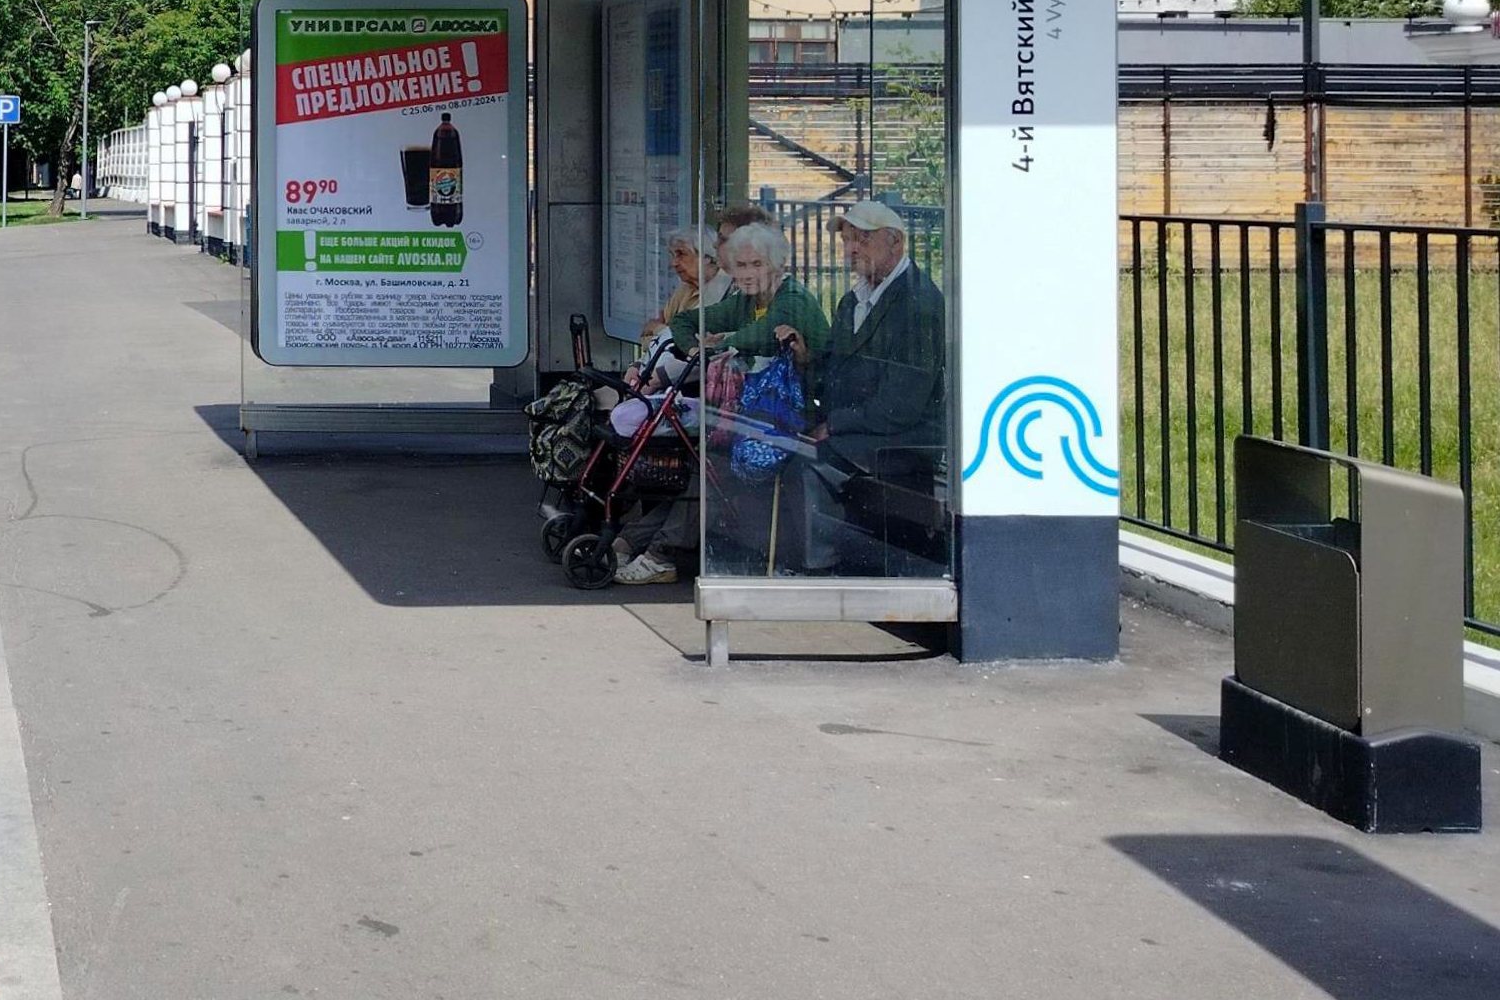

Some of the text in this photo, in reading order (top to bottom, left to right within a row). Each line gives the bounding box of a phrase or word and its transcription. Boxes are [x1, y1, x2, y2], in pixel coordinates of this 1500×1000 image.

[290, 20, 499, 32] УНИВЕРСАМ АВОСЬКА
[1047, 25, 1062, 40] 4
[291, 46, 451, 90] СПЕЦИАЛЬНОЕ
[295, 71, 464, 116] ПРЕДЛОЖЕНИЕ
[0, 99, 14, 120] P
[410, 105, 434, 115] 25.06
[435, 104, 446, 113] по
[448, 96, 496, 110] 08.07.2024
[1012, 126, 1034, 173] 4-й
[287, 205, 373, 215] Квас ОЧАКОВСКИЙ
[286, 217, 331, 227] заварной,
[320, 236, 457, 248] ЕЩЕ БОЛЬШЕ АКЦИЙ И СКИДОК
[320, 252, 462, 266] НА НАШЕМ САЙТЕ AVOSKA.RU
[324, 278, 362, 288] Москва,
[381, 278, 443, 288] Башиловская,
[459, 279, 470, 287] 21
